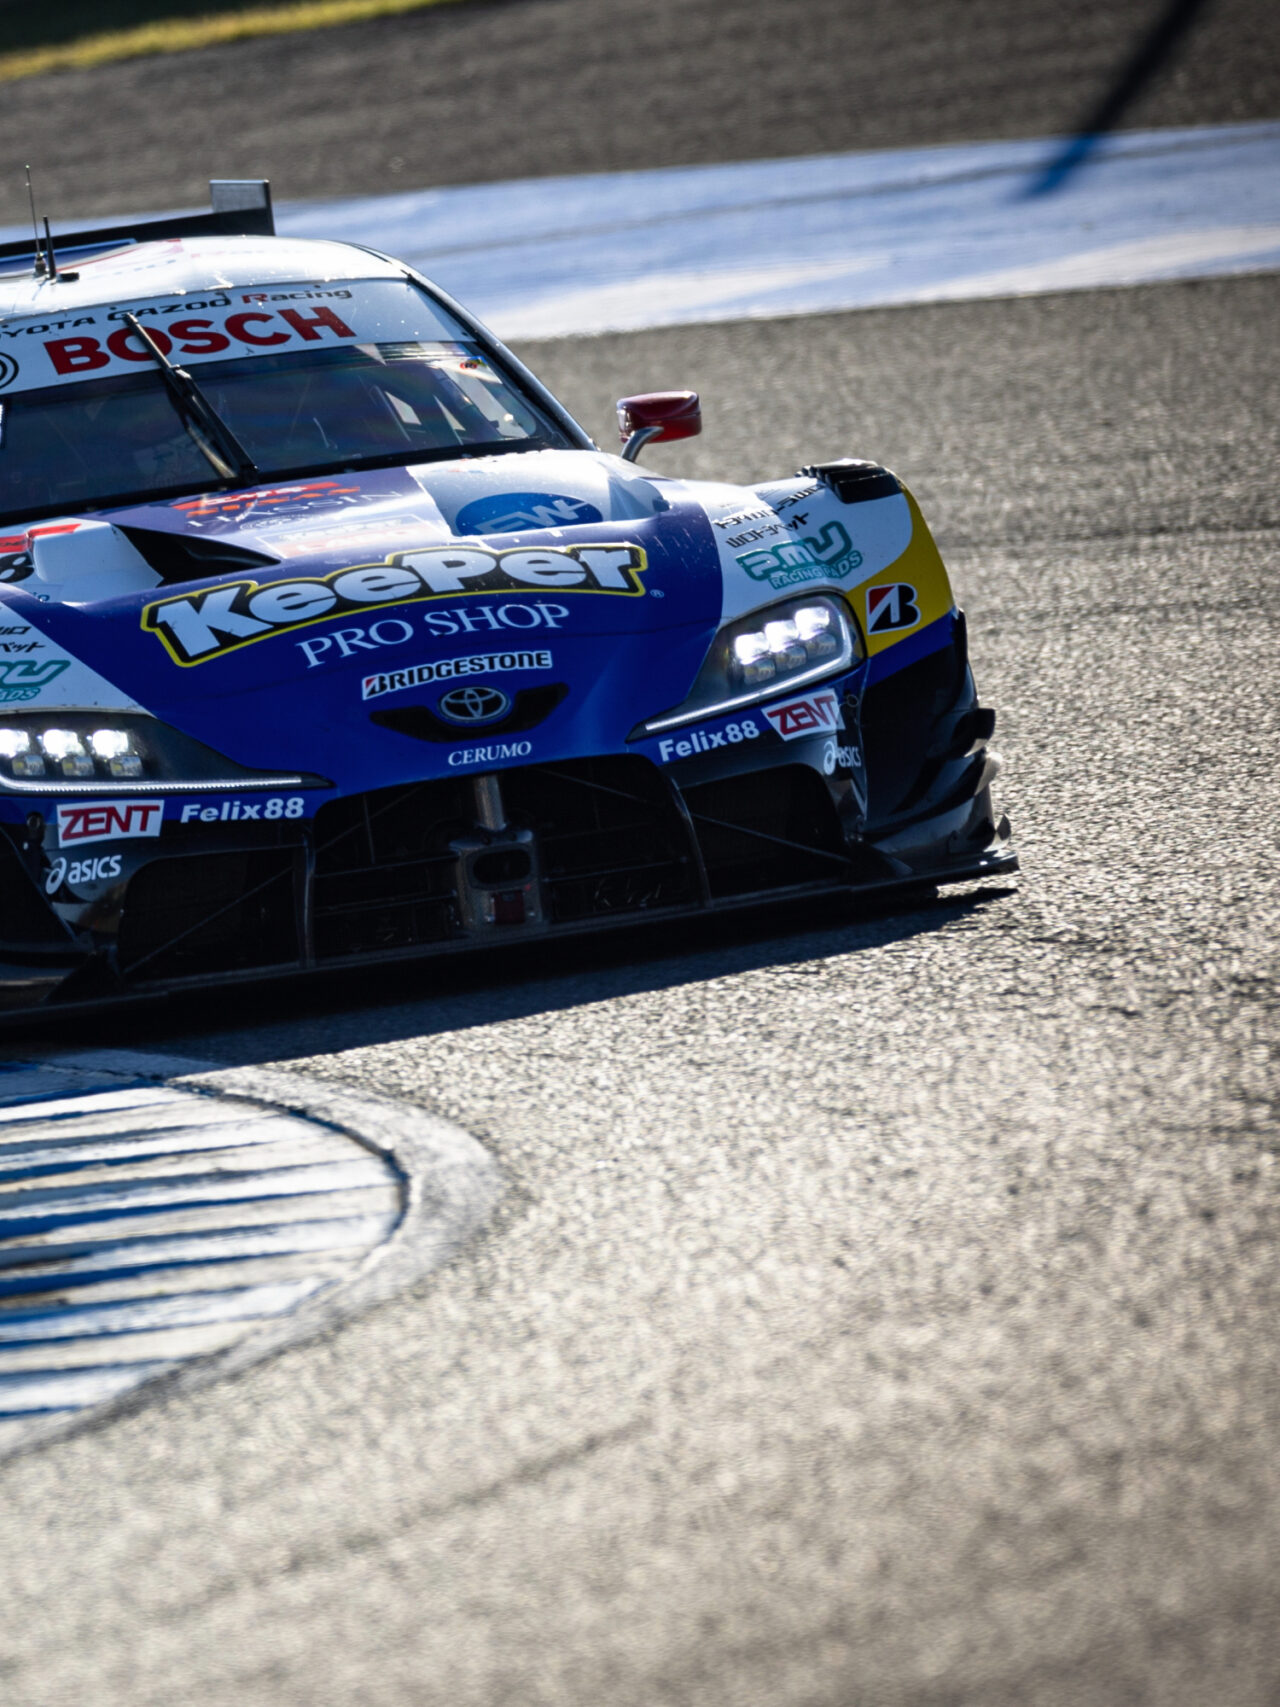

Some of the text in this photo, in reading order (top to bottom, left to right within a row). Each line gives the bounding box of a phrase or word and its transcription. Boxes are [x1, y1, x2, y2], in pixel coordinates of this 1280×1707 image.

[241, 288, 353, 304] Racing
[44, 306, 357, 375] BOSCH
[769, 566, 822, 590] RACING
[148, 546, 642, 662] KeePer
[296, 603, 569, 669] PRO SHOP
[365, 651, 551, 699] BRIDGESTONE
[767, 694, 840, 736] ZENT
[448, 740, 532, 766] CERUMO
[659, 720, 760, 763] Felix88
[60, 804, 161, 841] ZENT
[180, 797, 304, 824] Felix88
[67, 855, 122, 885] asics
